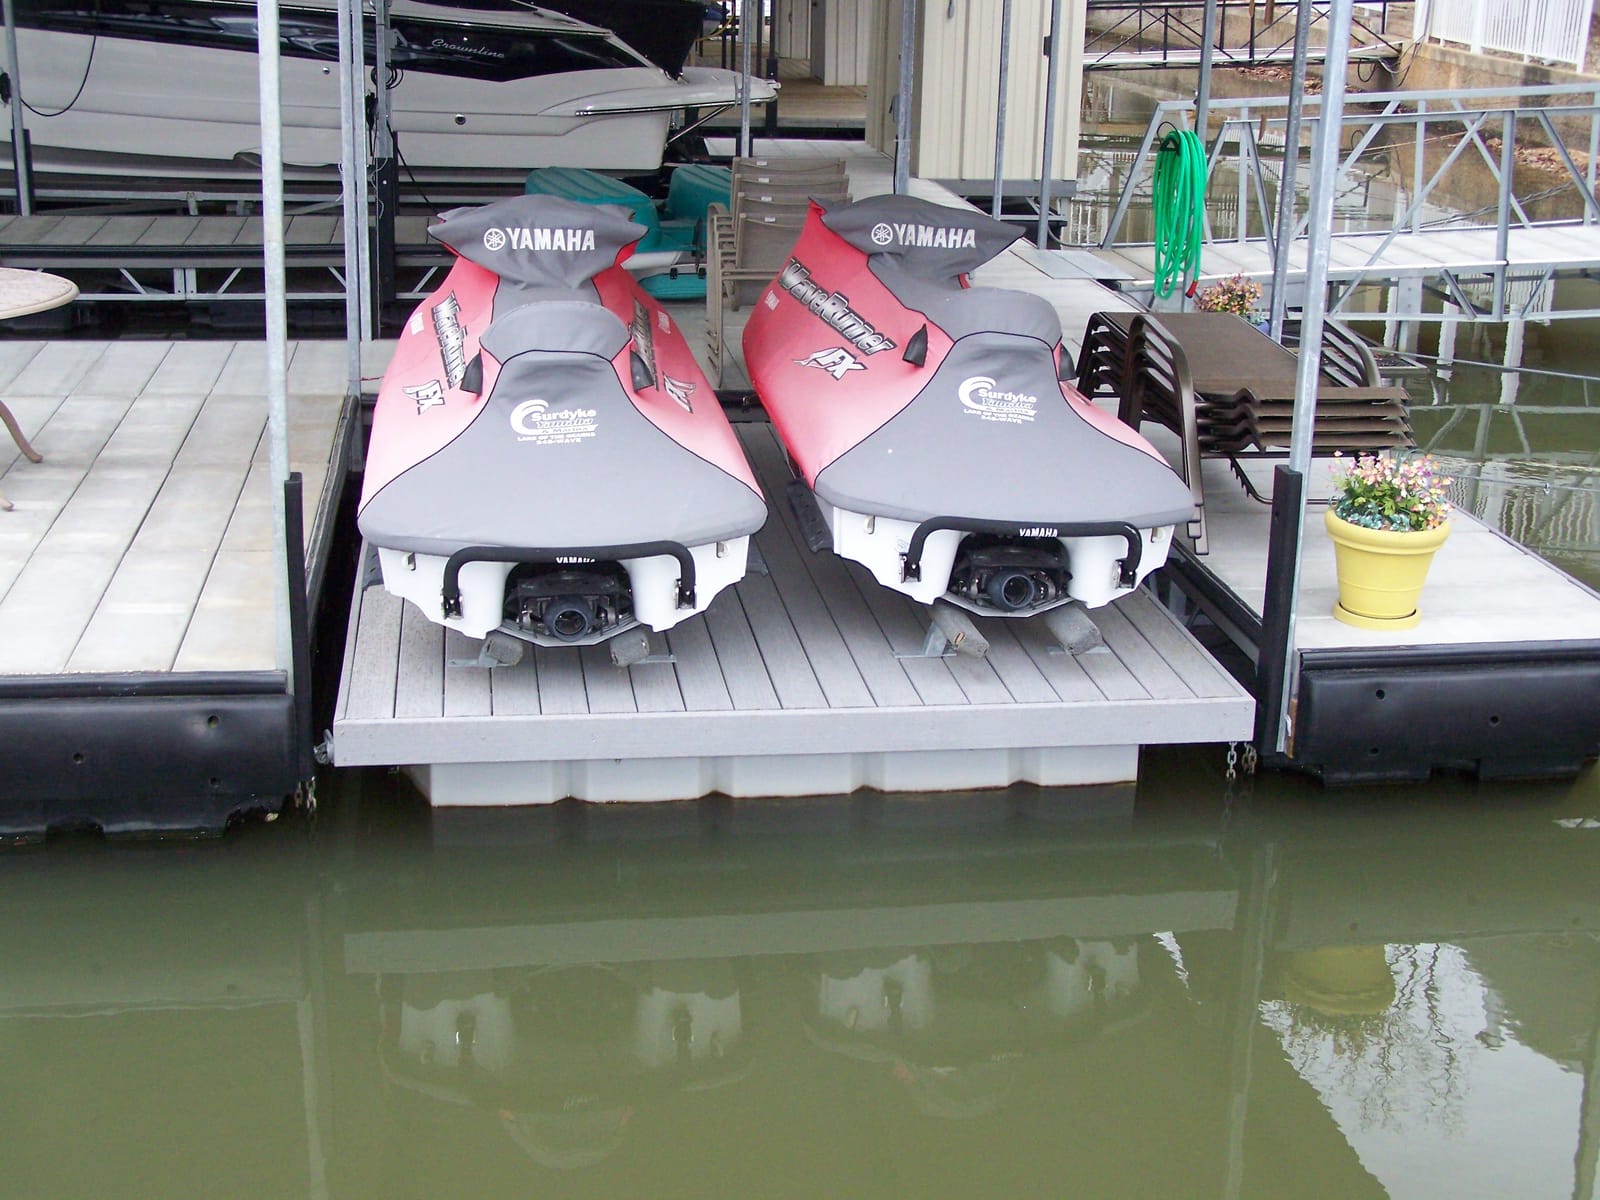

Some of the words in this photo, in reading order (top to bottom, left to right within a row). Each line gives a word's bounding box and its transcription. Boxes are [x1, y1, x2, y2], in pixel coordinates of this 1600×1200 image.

[431, 38, 505, 58] Crownline
[505, 227, 596, 251] YAMAHA
[893, 223, 977, 249] YAMAHA
[778, 257, 897, 356] WaveRunner
[431, 290, 468, 390] WaveRunne
[978, 388, 1037, 403] Surdyke
[531, 409, 597, 421] Surdyke
[1019, 527, 1059, 538] YAMAHA
